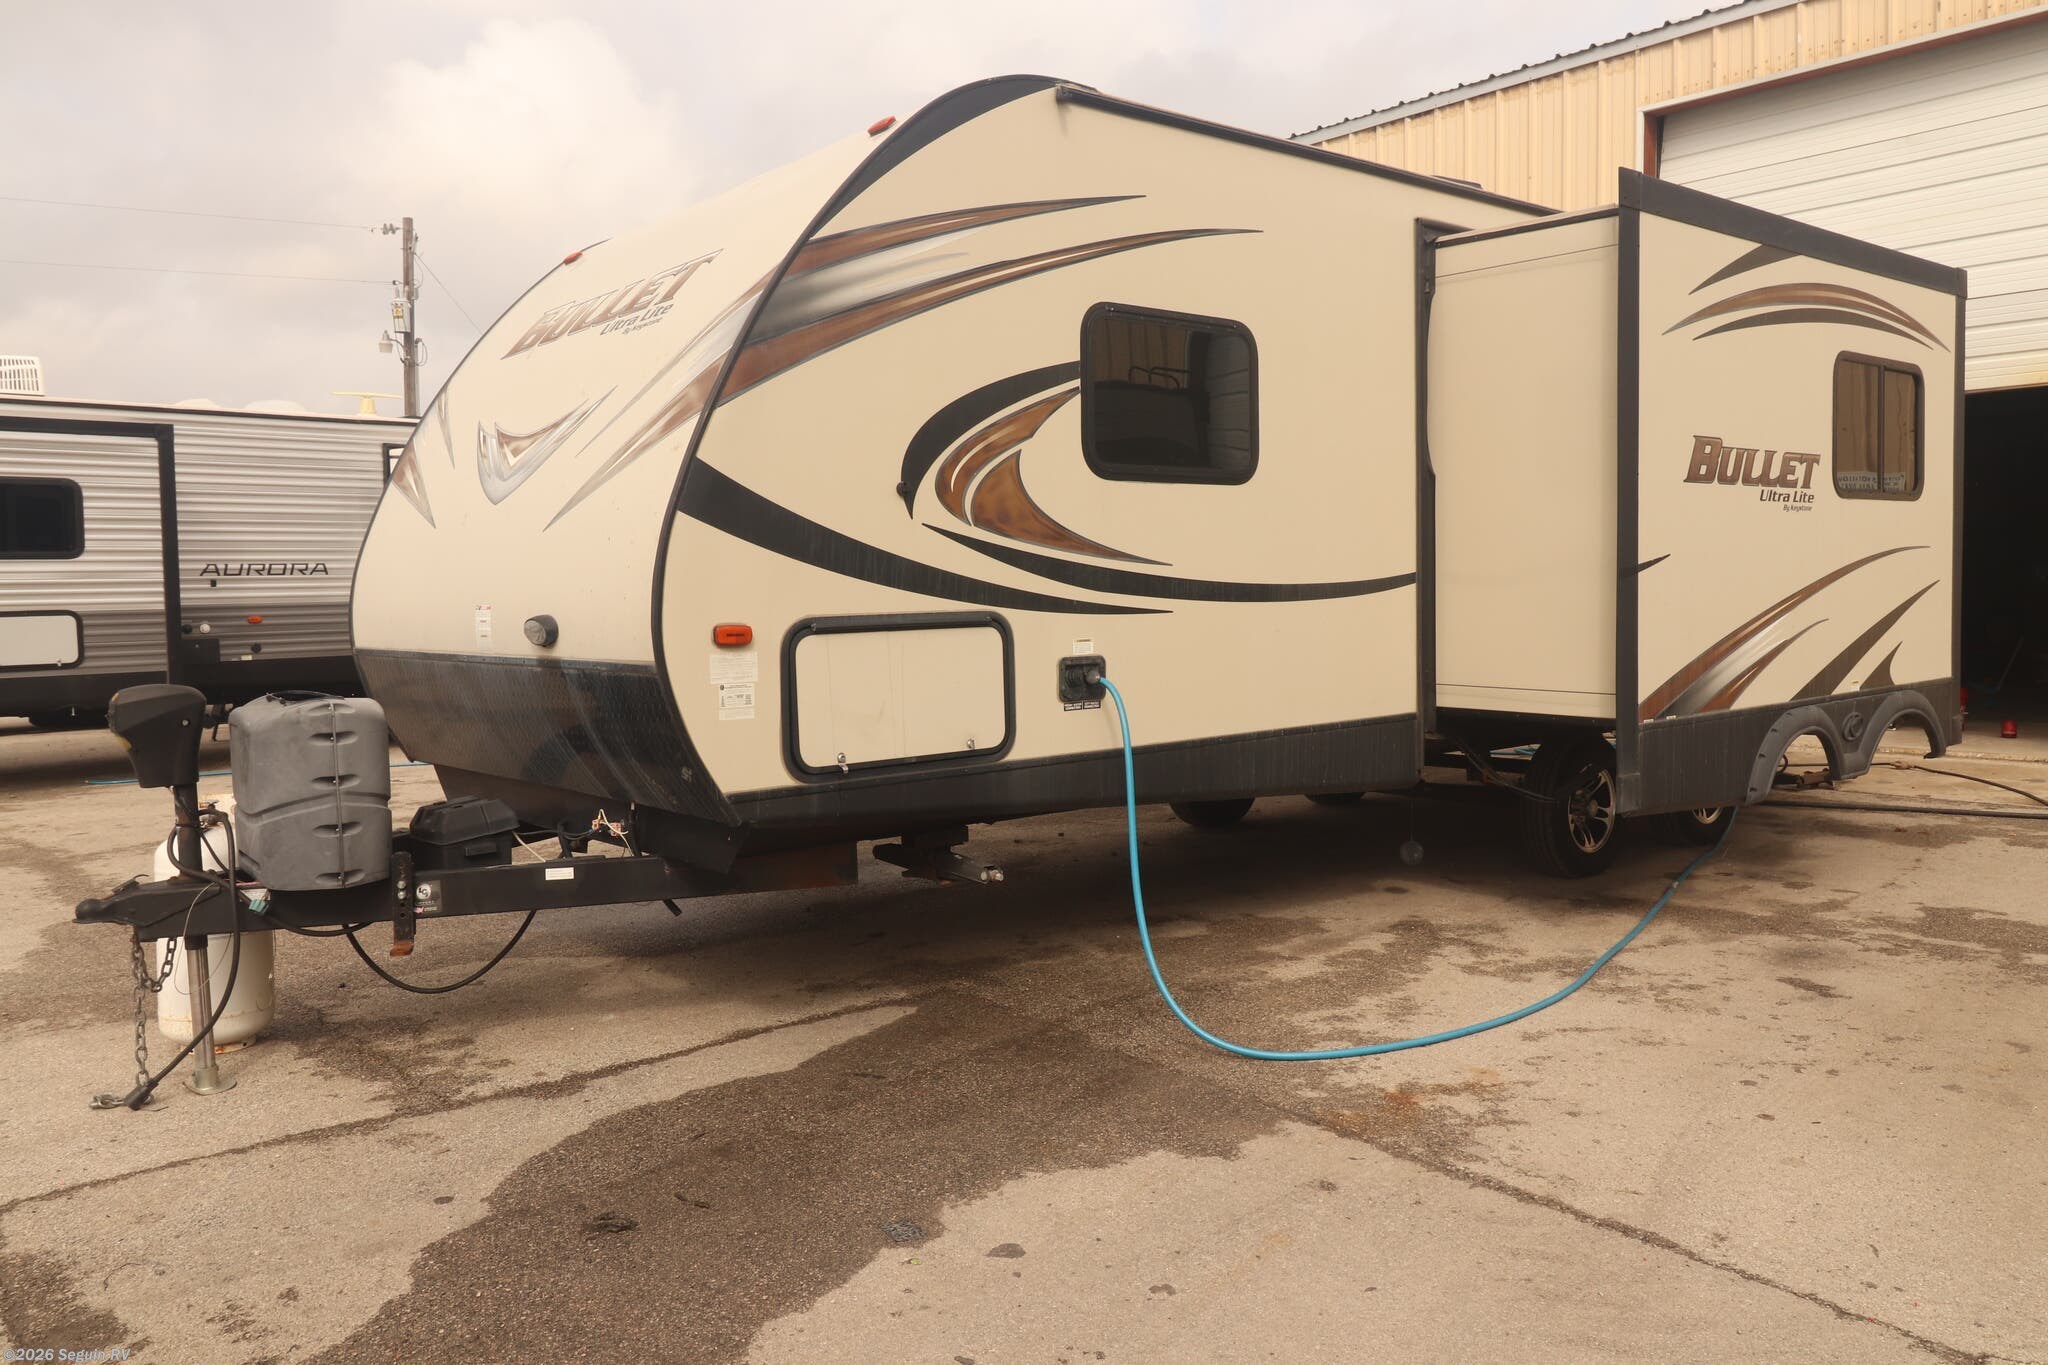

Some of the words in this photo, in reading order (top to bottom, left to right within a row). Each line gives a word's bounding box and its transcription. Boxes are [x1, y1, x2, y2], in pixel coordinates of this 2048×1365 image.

[500, 248, 724, 359] BULLET
[600, 314, 641, 336] Ultra
[642, 303, 674, 323] Lite
[1683, 435, 1821, 489] BULLET
[1760, 489, 1790, 503] Ultra
[1793, 490, 1815, 504] Lite
[200, 563, 329, 577] AURORA
